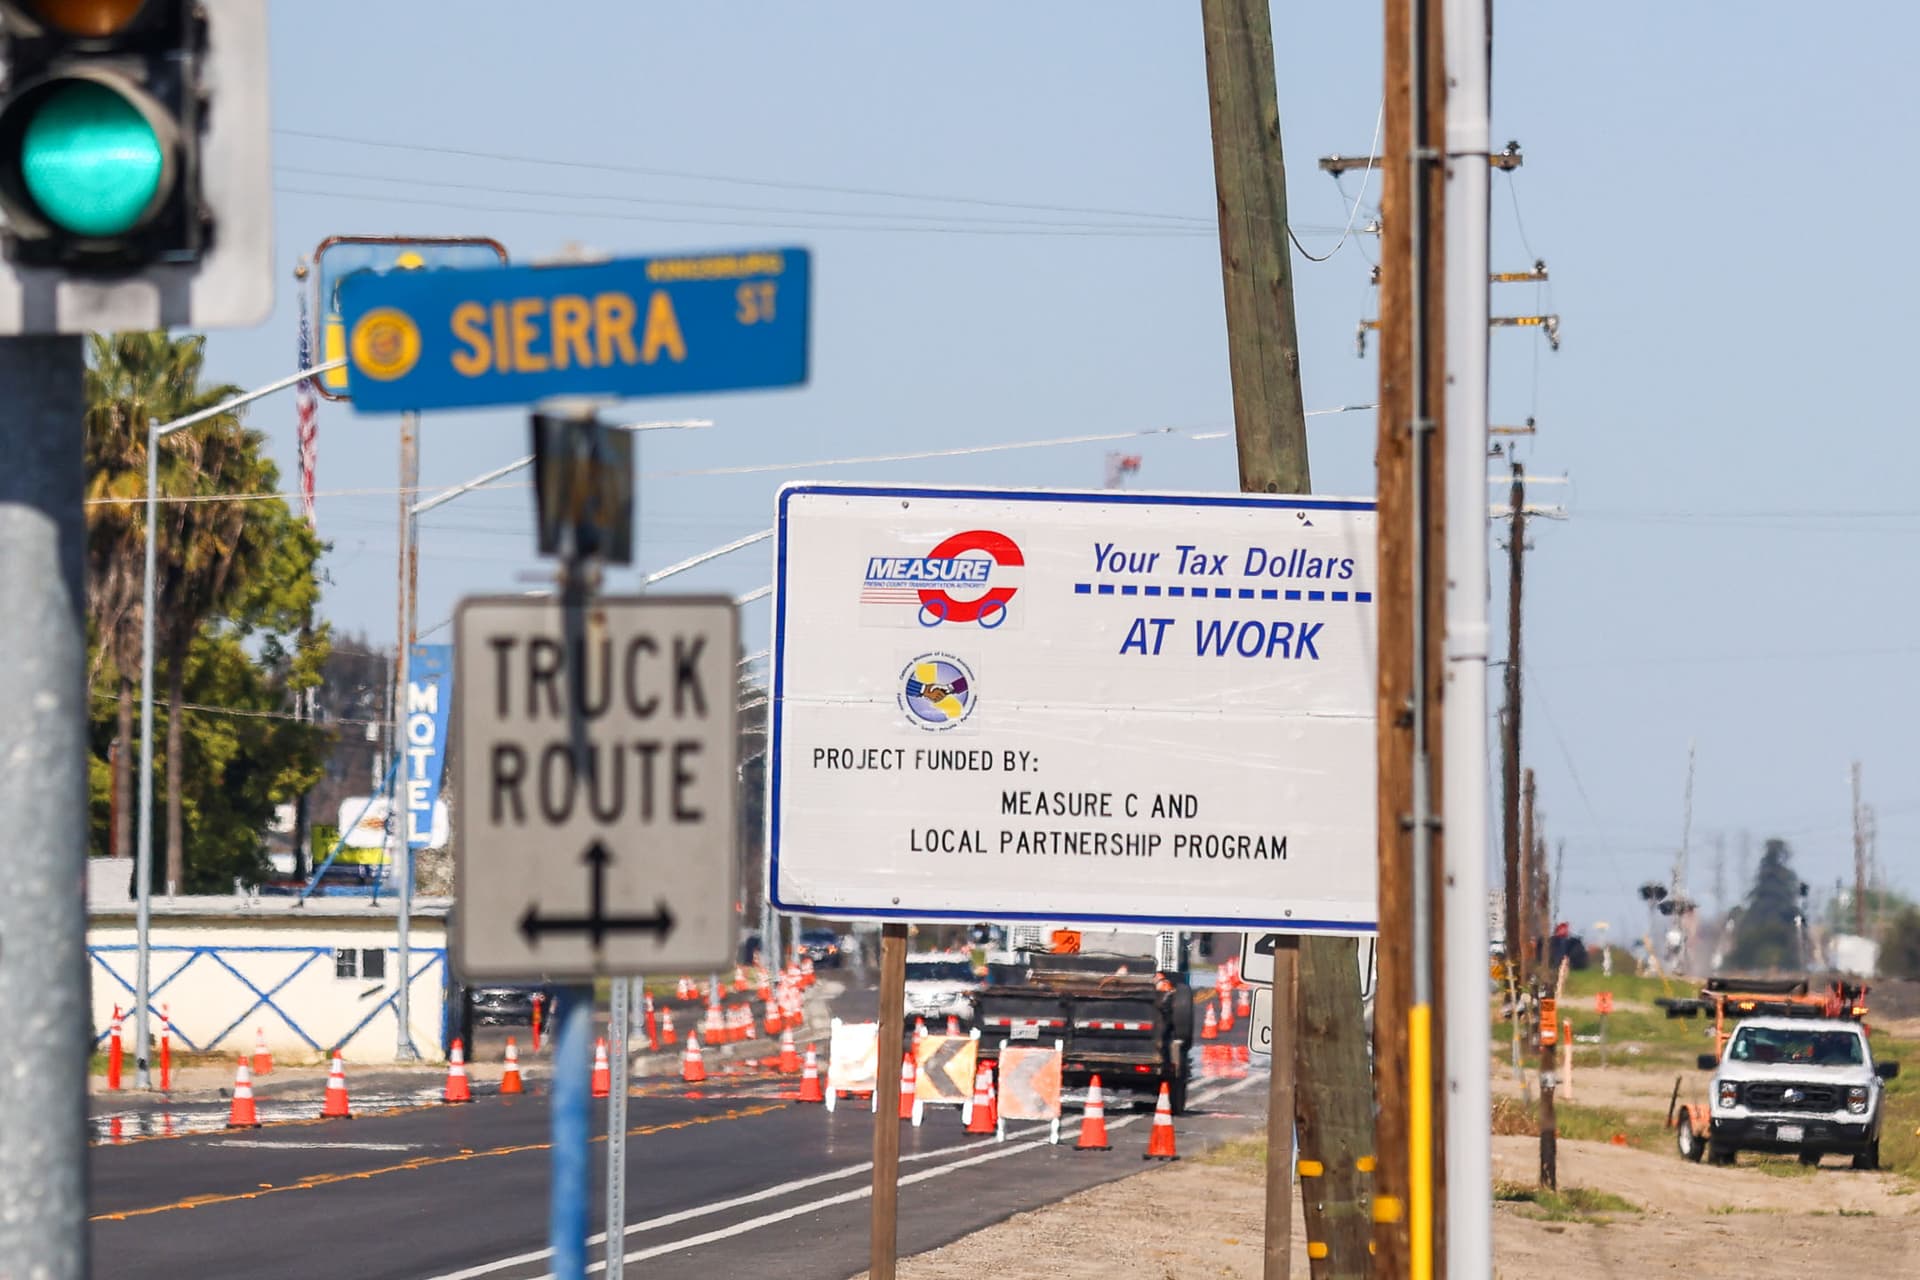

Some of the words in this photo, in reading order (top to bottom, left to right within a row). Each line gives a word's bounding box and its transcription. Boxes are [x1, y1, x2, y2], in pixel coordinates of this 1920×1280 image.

[451, 291, 687, 376] SIERRA
[735, 281, 777, 326] ST
[867, 558, 988, 581] MEASURE
[1094, 543, 1159, 574] Your
[1175, 545, 1228, 576] Tax
[1243, 547, 1355, 580] Dollars
[1119, 617, 1175, 656] AT
[1196, 619, 1325, 660] WORK
[487, 634, 708, 720] TRUCK
[407, 681, 438, 842] MOTEL
[813, 747, 906, 771] PROJECT
[914, 749, 993, 772] FUNDED
[1003, 750, 1039, 773] BY:
[488, 740, 705, 826] ROUTE
[1002, 790, 1113, 818] MEASURE
[1125, 793, 1139, 819] C
[1151, 793, 1199, 819] AND
[911, 828, 987, 855] LOCAL
[1000, 830, 1162, 858] PARTNERSHIP
[1174, 833, 1288, 861] PROGRAM
